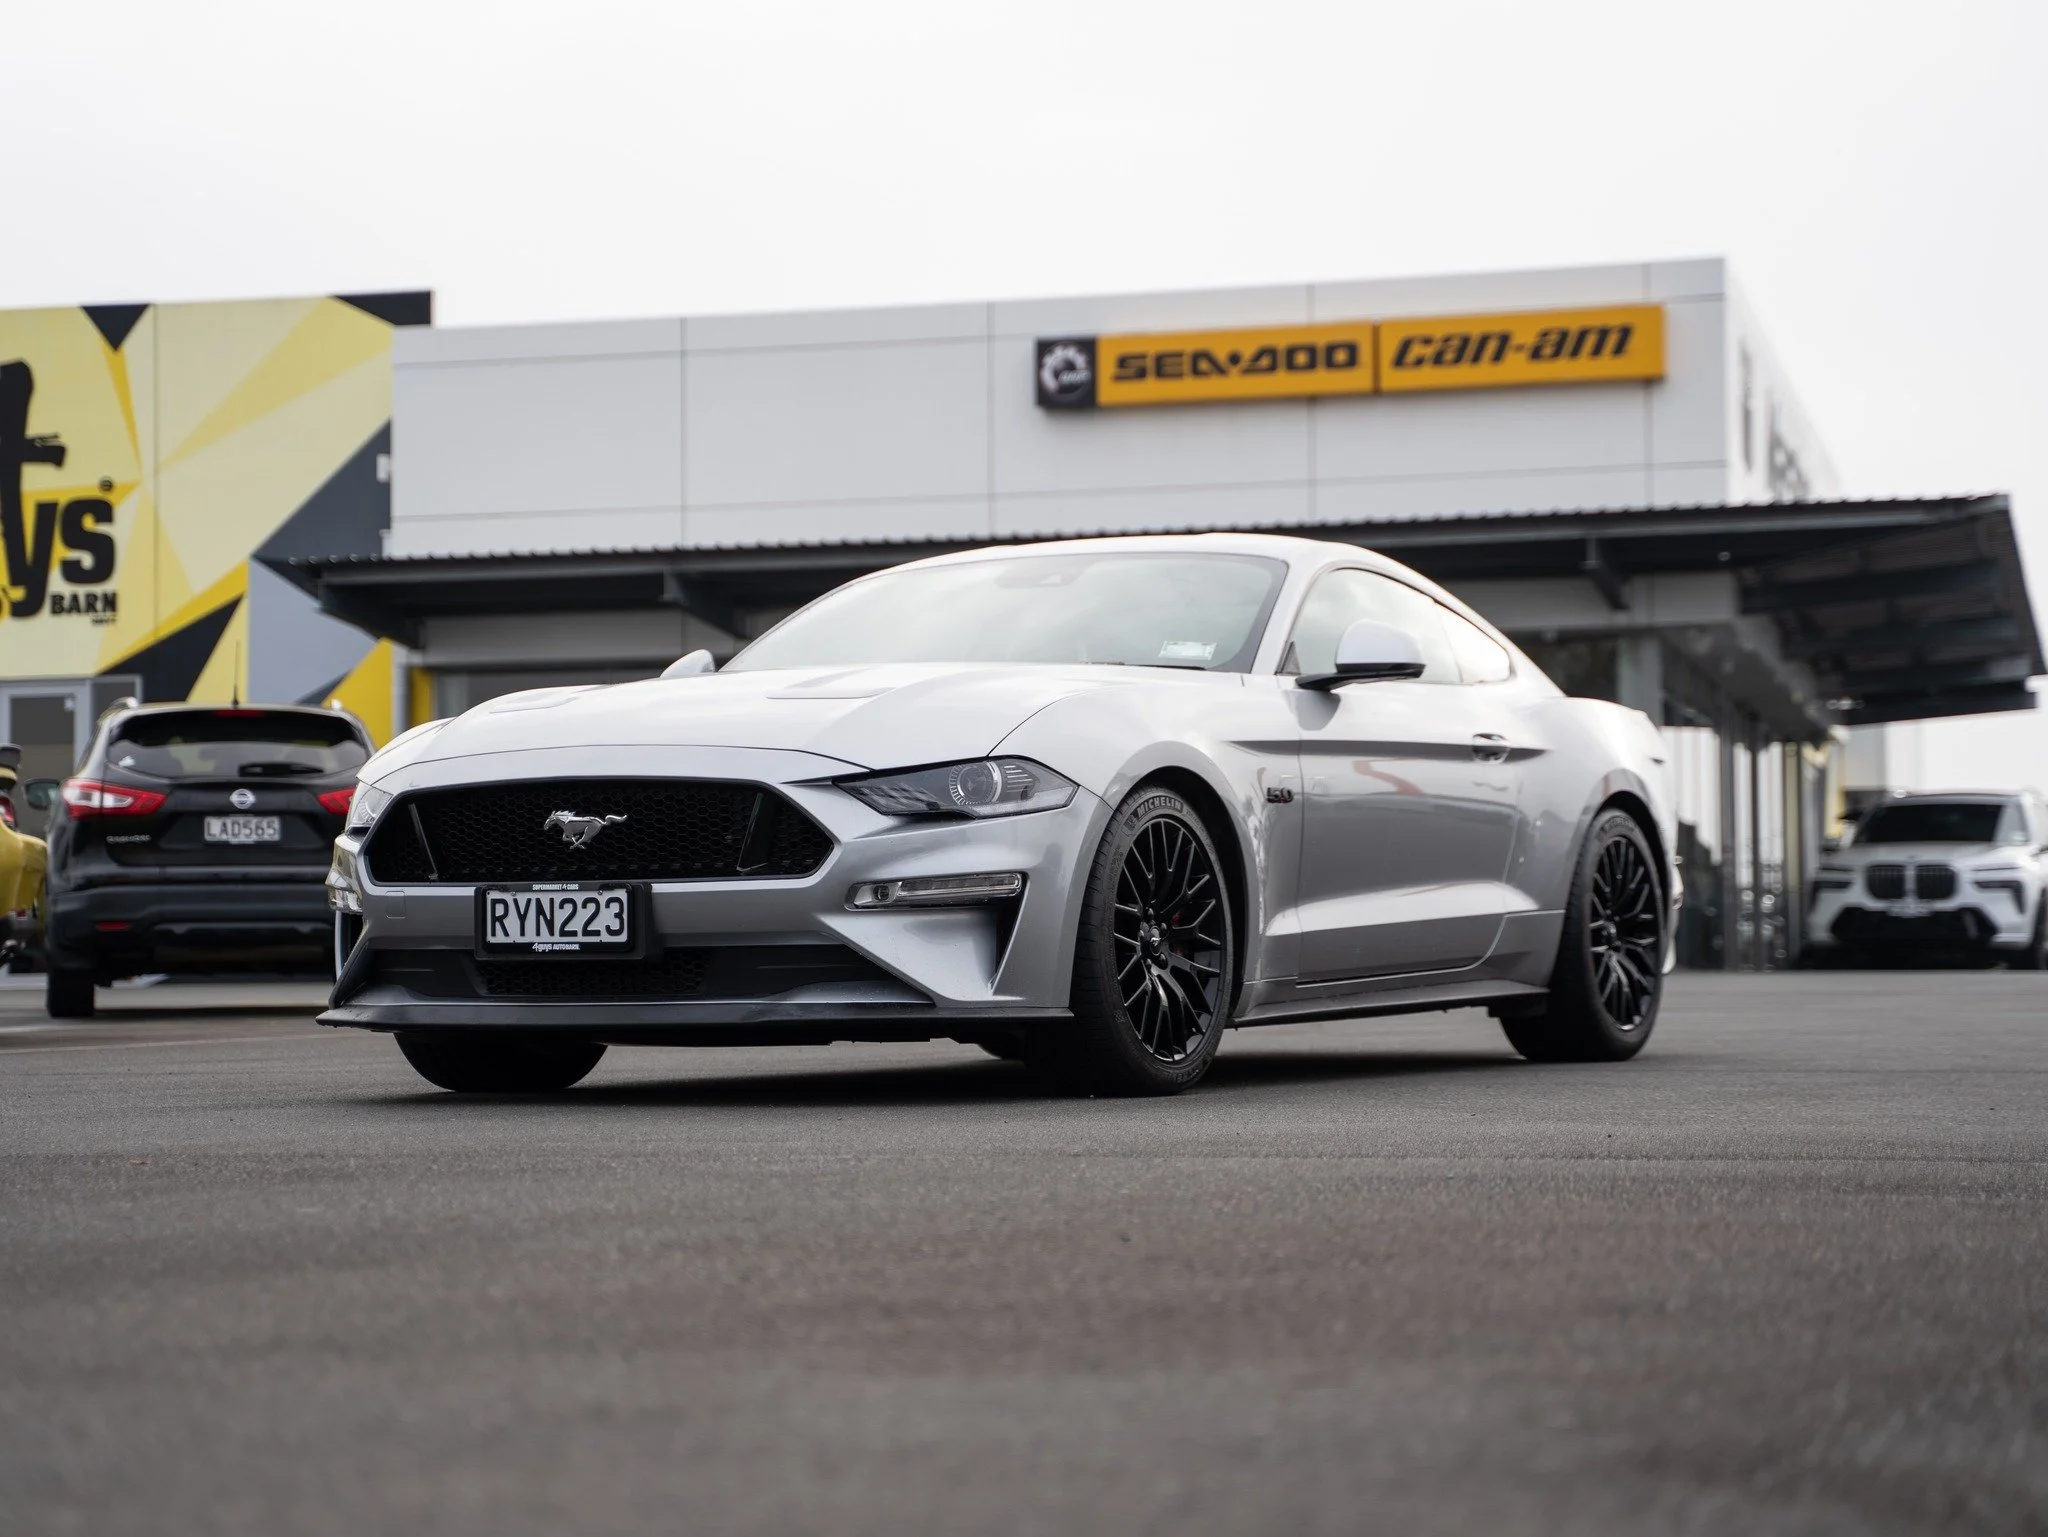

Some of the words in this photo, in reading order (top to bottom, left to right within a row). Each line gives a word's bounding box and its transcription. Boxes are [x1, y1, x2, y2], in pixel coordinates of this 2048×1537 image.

[51, 592, 117, 615] BARN
[1137, 796, 1183, 815] MICHELIN
[490, 897, 625, 937] RYN223
